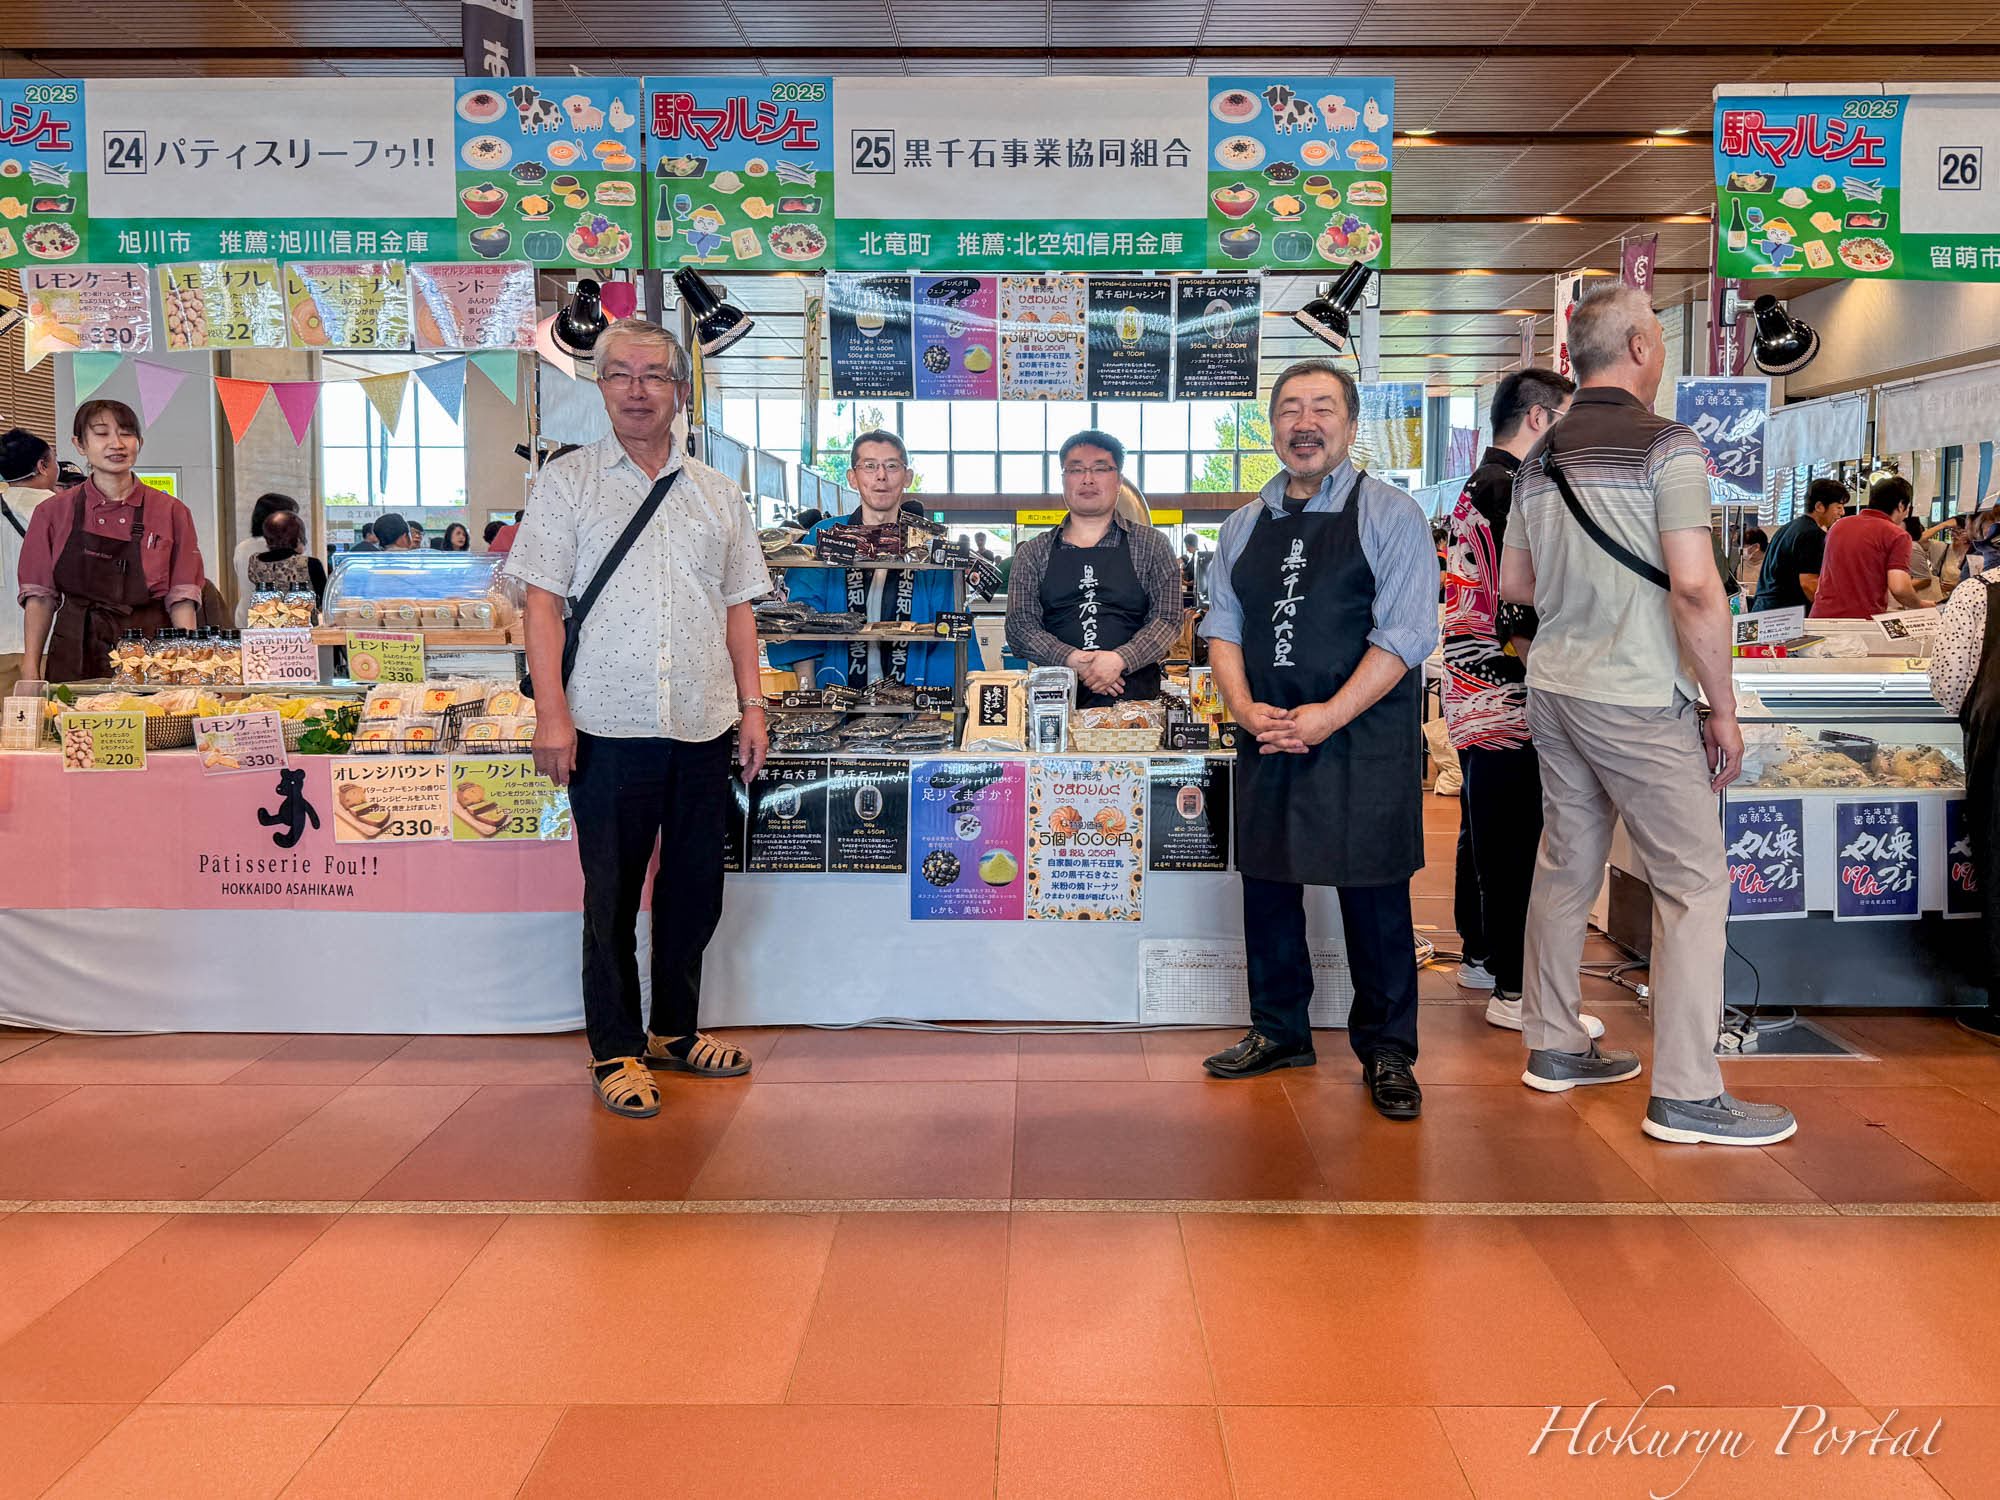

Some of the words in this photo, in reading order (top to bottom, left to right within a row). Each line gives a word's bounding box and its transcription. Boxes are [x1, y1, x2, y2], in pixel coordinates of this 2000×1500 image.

[25, 85, 78, 103] 2025
[772, 83, 826, 102] 2025
[1842, 100, 1899, 118] 2025
[652, 92, 819, 149] 駅マルシェ
[1721, 110, 1886, 166] 駅マルシェ
[107, 137, 143, 168] 24
[855, 136, 891, 168] 25
[903, 138, 1192, 168] 黒千石事業協同組合
[1942, 153, 1977, 184] 26
[118, 230, 191, 254] 旭川市
[219, 229, 429, 254] 推薦:旭川信用金庫
[858, 231, 932, 256] 北竜町
[957, 231, 1183, 257] 推薦:北空知信用金庫
[1930, 245, 2000, 269] 留萌市
[35, 271, 138, 289] レモンケーキ
[169, 270, 266, 290] レモサブレ
[1182, 286, 1256, 298] 黒千石ペット茶
[91, 328, 132, 343] 330
[251, 644, 308, 654] レモンサブレ
[349, 640, 420, 653] レモンドーナツ
[280, 667, 311, 678] 1000
[388, 671, 414, 682] 330
[68, 718, 137, 730] レモンサブレ
[200, 715, 273, 733] レモンケーキ
[106, 753, 133, 765] 220
[246, 753, 275, 767] 330
[454, 762, 540, 780] ケークシト
[757, 769, 817, 781] 黒千石大豆
[1053, 784, 1120, 795] ひまわりんぐ
[392, 819, 432, 836] 330
[511, 816, 540, 833] 33
[1040, 832, 1066, 846] 5個
[1073, 832, 1133, 846] 1000円
[199, 853, 311, 873] Pâtisserie
[325, 855, 378, 875] Fou!!
[1048, 859, 1124, 867] 自家製の黒千石豆乳
[1051, 871, 1118, 879] 幻の黒千石きなこ
[222, 882, 282, 895] HOKKAIDO
[286, 883, 354, 896] ASAHIKAWA
